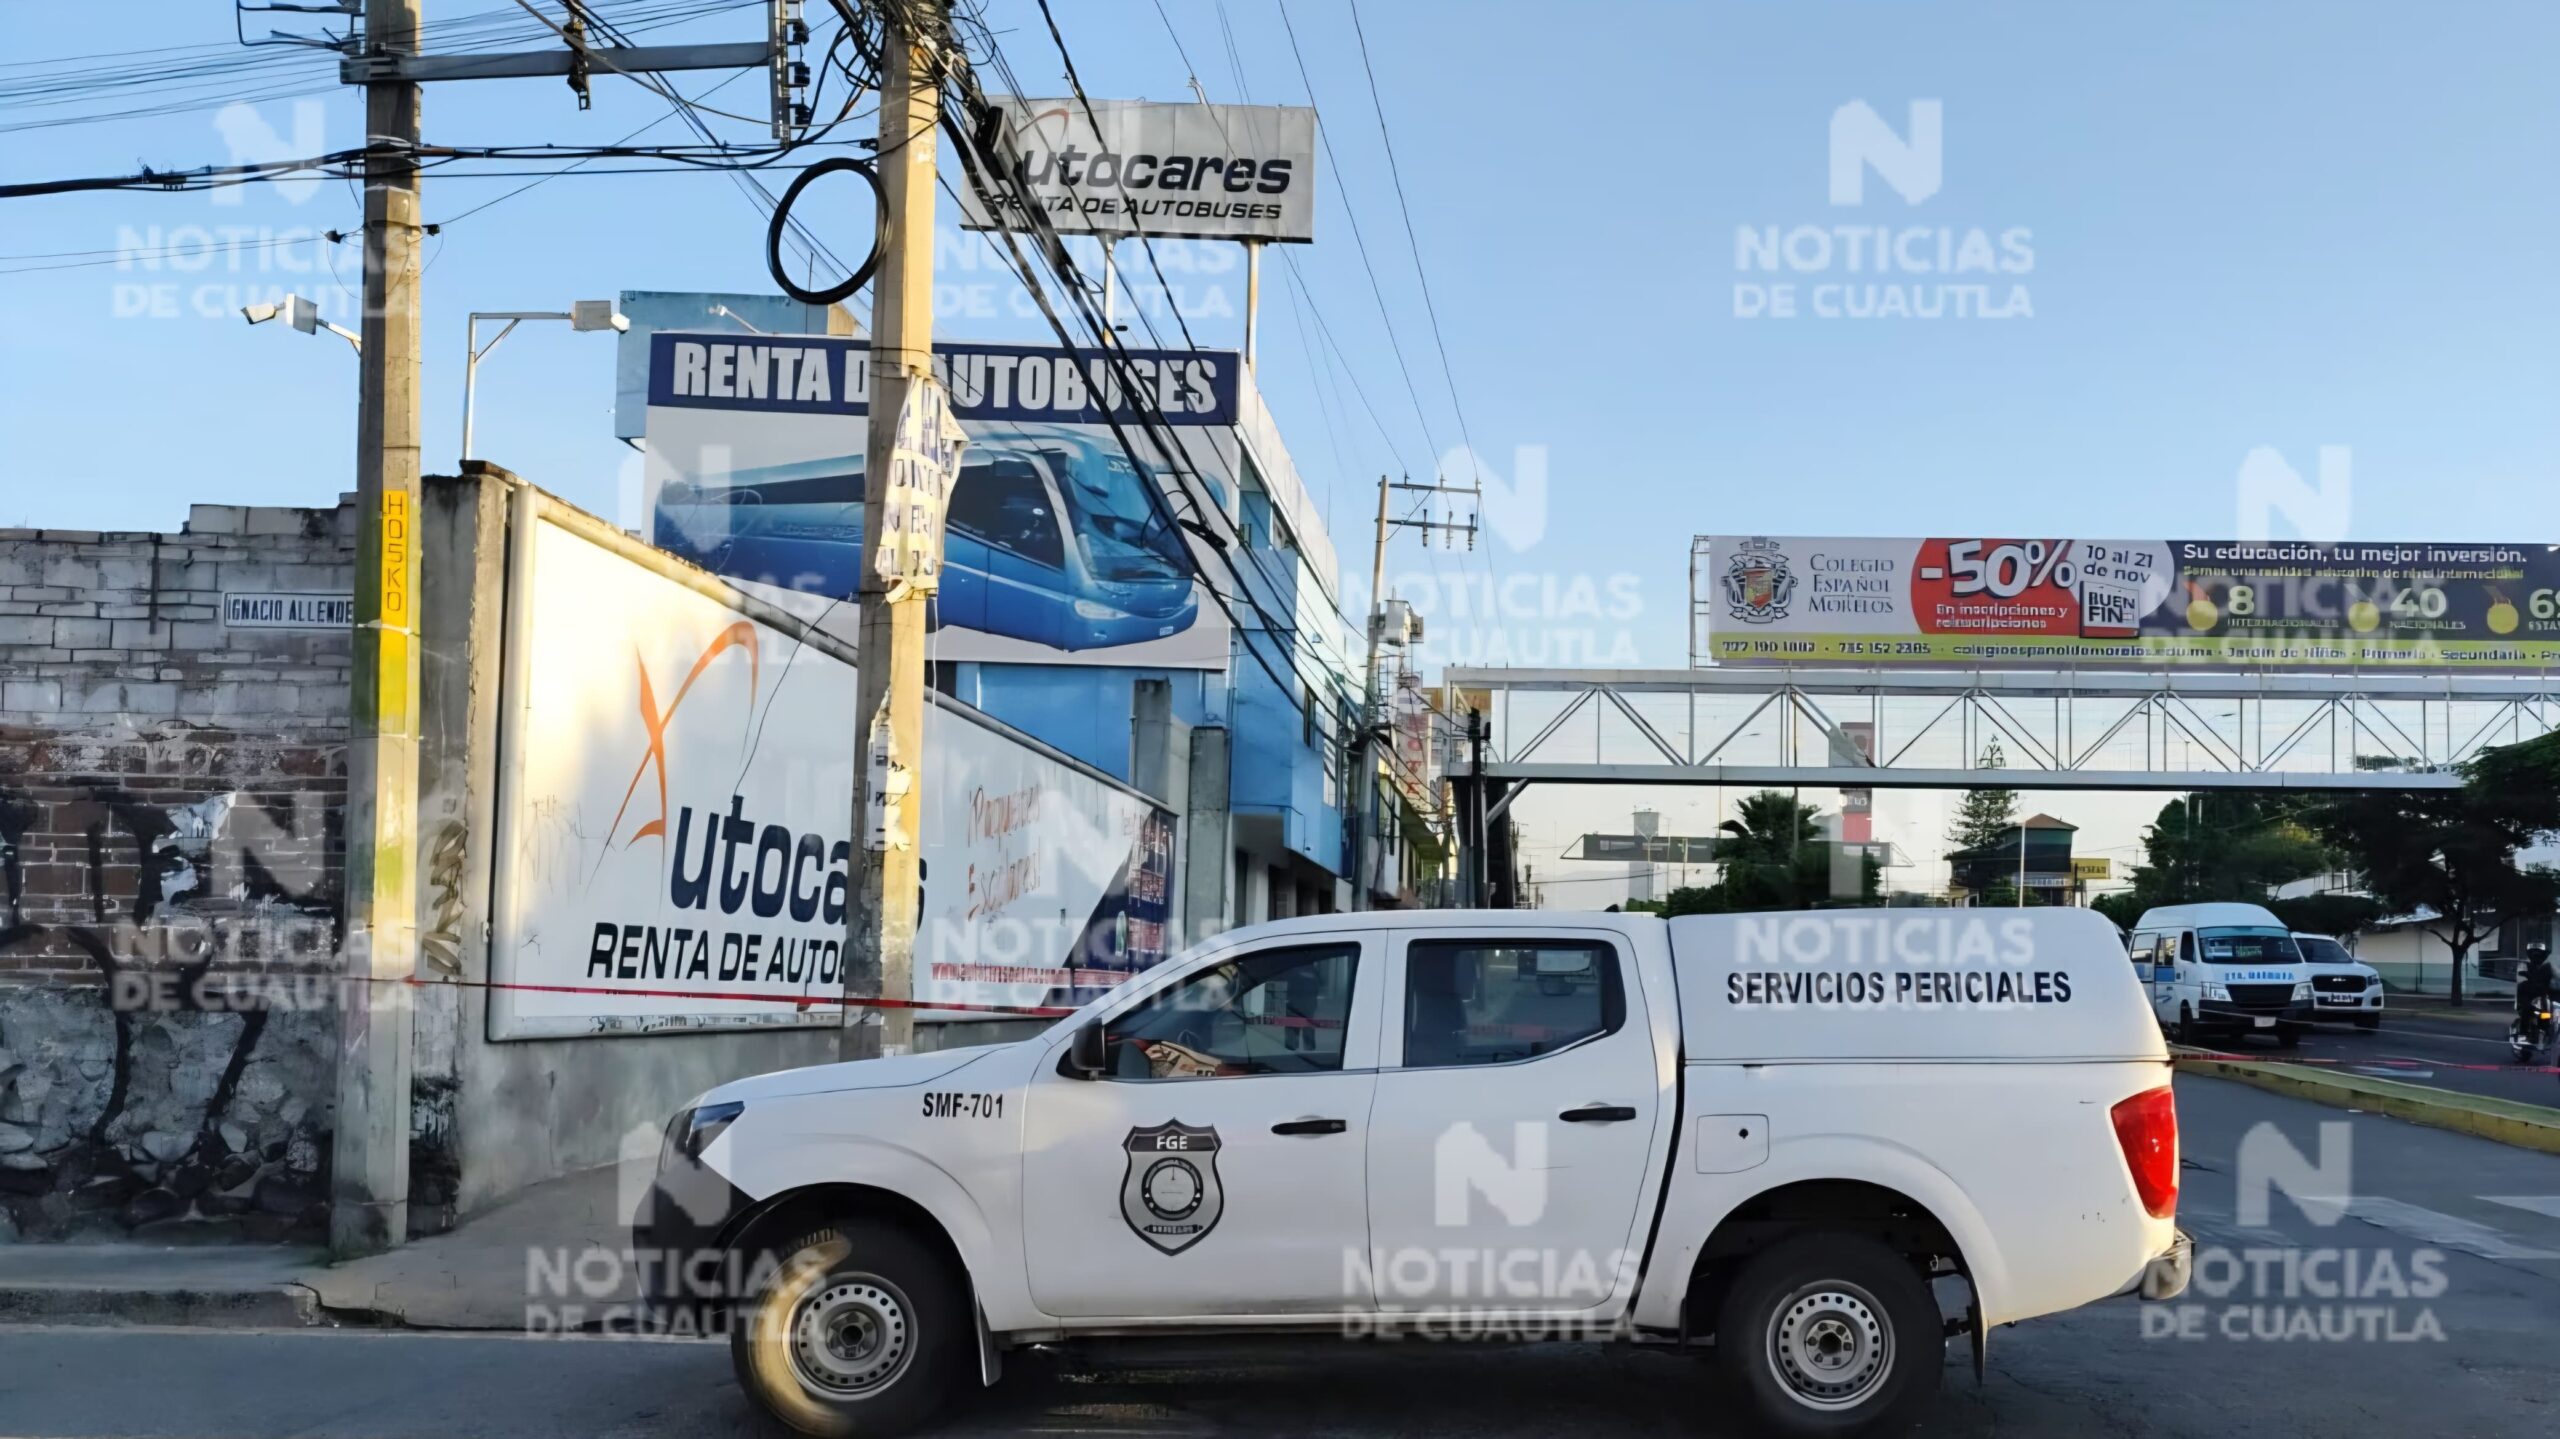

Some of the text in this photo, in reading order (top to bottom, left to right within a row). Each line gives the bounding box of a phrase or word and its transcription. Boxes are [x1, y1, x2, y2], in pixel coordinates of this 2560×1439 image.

[1083, 197, 1118, 214] DE
[1121, 198, 1282, 219] AUTOBUSES
[673, 342, 831, 402] RENTA
[844, 350, 870, 402] D
[2087, 545, 2154, 568] 10 al 21
[2184, 544, 2527, 565] Su educación, tu mejor inversión.
[1920, 538, 2076, 600] -50%
[2084, 562, 2151, 584] de nov
[227, 599, 353, 624] IGNACIO ALLENDE
[2057, 606, 2068, 619] y
[2088, 591, 2136, 610] BUEN
[2228, 585, 2255, 616] 8
[2390, 587, 2447, 618] 40
[2529, 588, 2560, 619] 6
[2088, 606, 2123, 624] FIN
[587, 922, 710, 980] RENTA
[719, 933, 763, 981] DE
[1727, 971, 2072, 1005] SERVICIOS PERICIALES
[922, 1091, 1004, 1119] SMF-701
[1156, 1135, 1189, 1150] FGE
